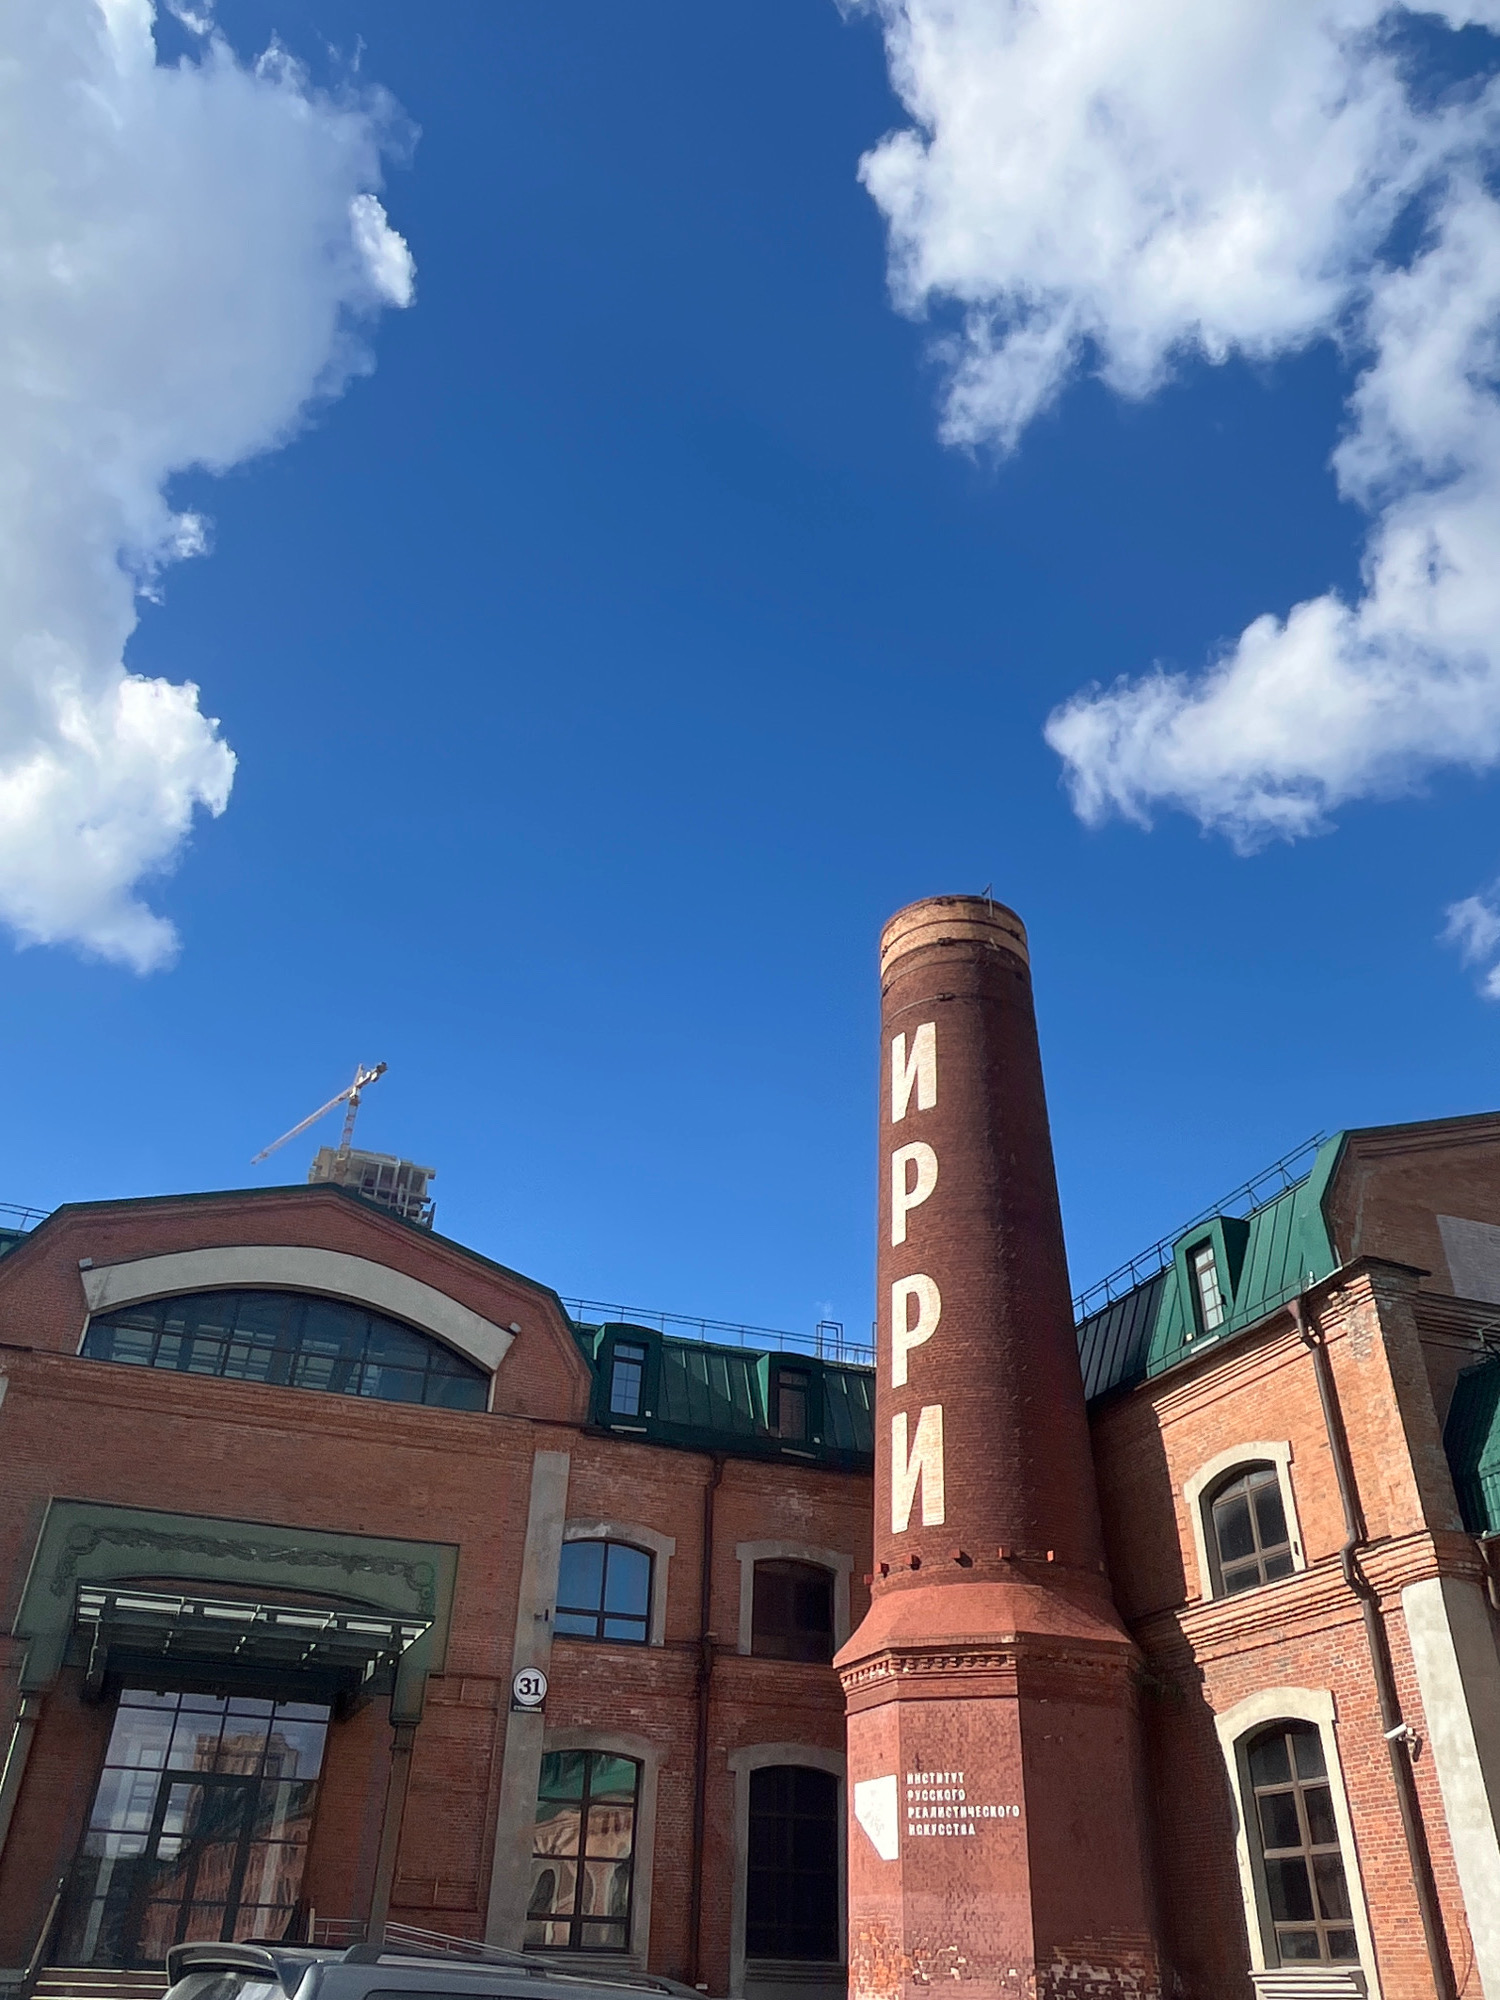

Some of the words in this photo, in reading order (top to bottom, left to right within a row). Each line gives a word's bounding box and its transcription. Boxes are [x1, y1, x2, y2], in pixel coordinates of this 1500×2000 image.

[890, 1021, 945, 1535] ИРРИ
[518, 1677, 541, 1696] 31
[906, 1771, 965, 1785] ИНСТИТУТ
[906, 1788, 966, 1803] РУССКОГО
[907, 1804, 1020, 1820] РЕАЛИСТИЧЕСКОГО
[908, 1821, 976, 1837] ИСКУССТВА
